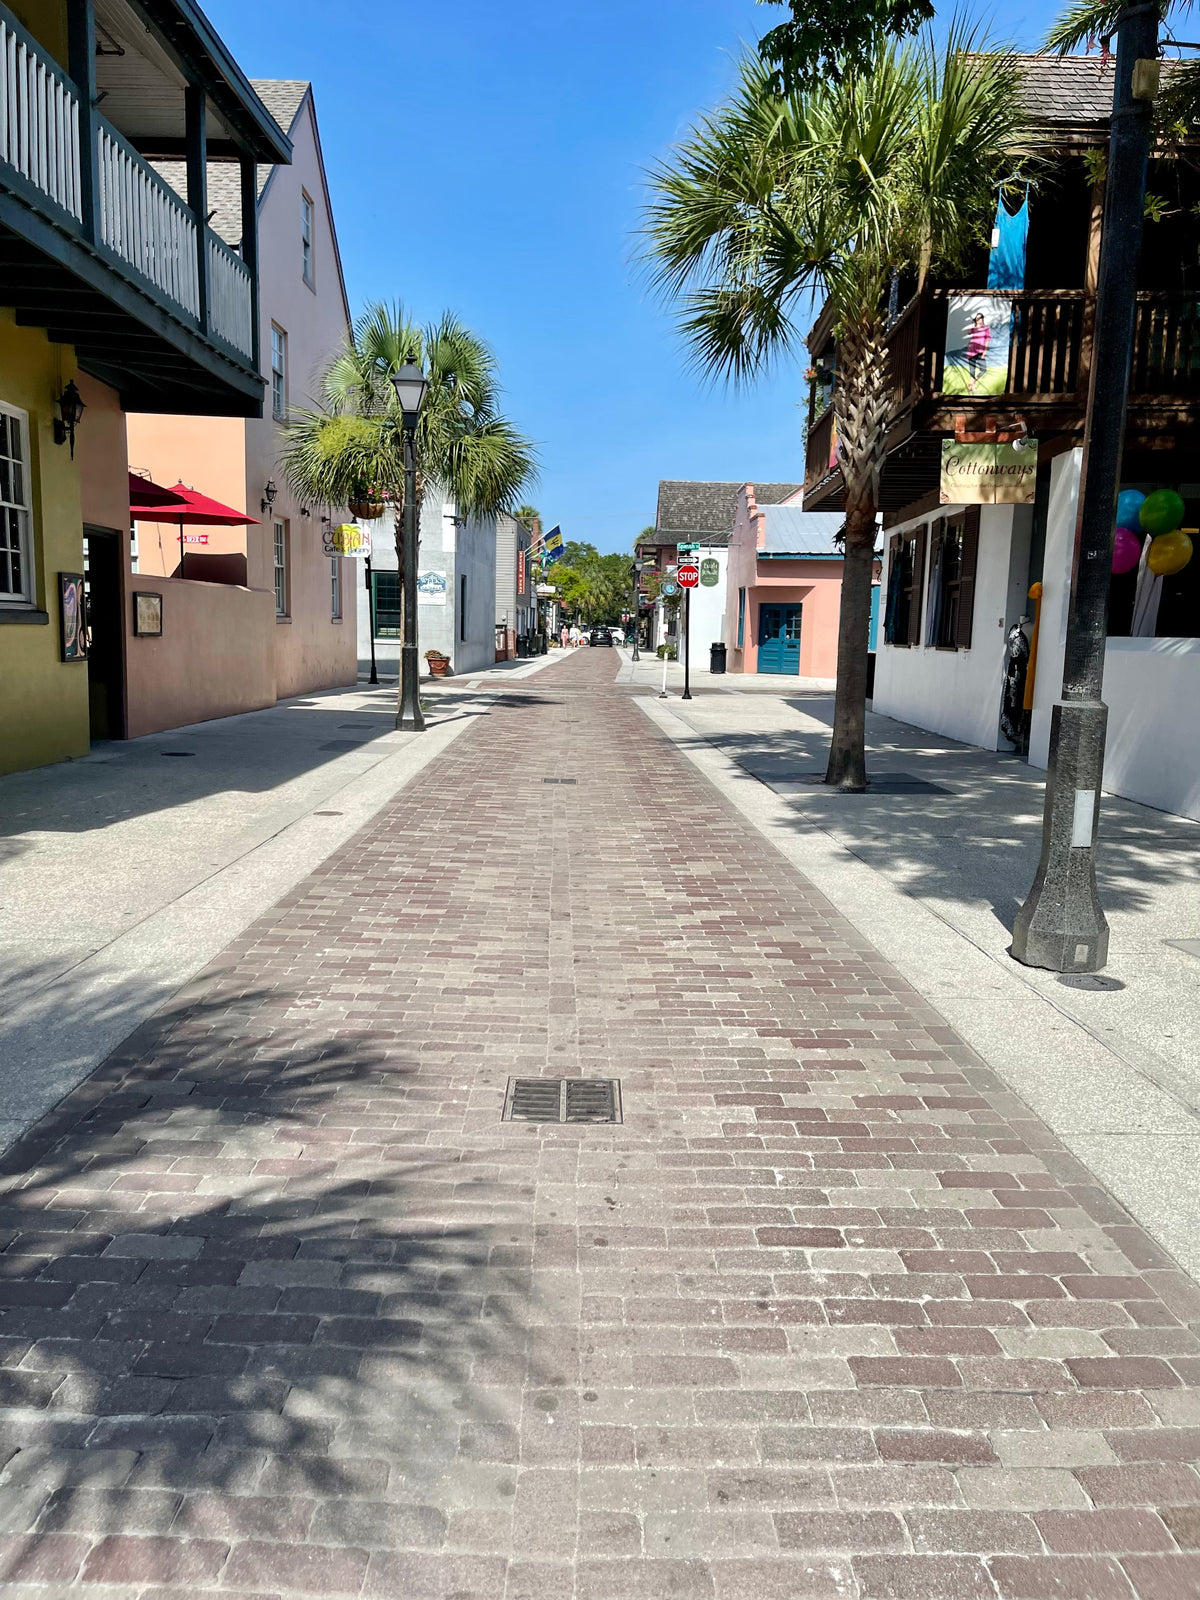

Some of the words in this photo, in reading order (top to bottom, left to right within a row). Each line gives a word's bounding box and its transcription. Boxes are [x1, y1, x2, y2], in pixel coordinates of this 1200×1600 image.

[945, 455, 1034, 484] Cottonways
[322, 531, 370, 547] CUBAN
[680, 571, 698, 582] STOP
